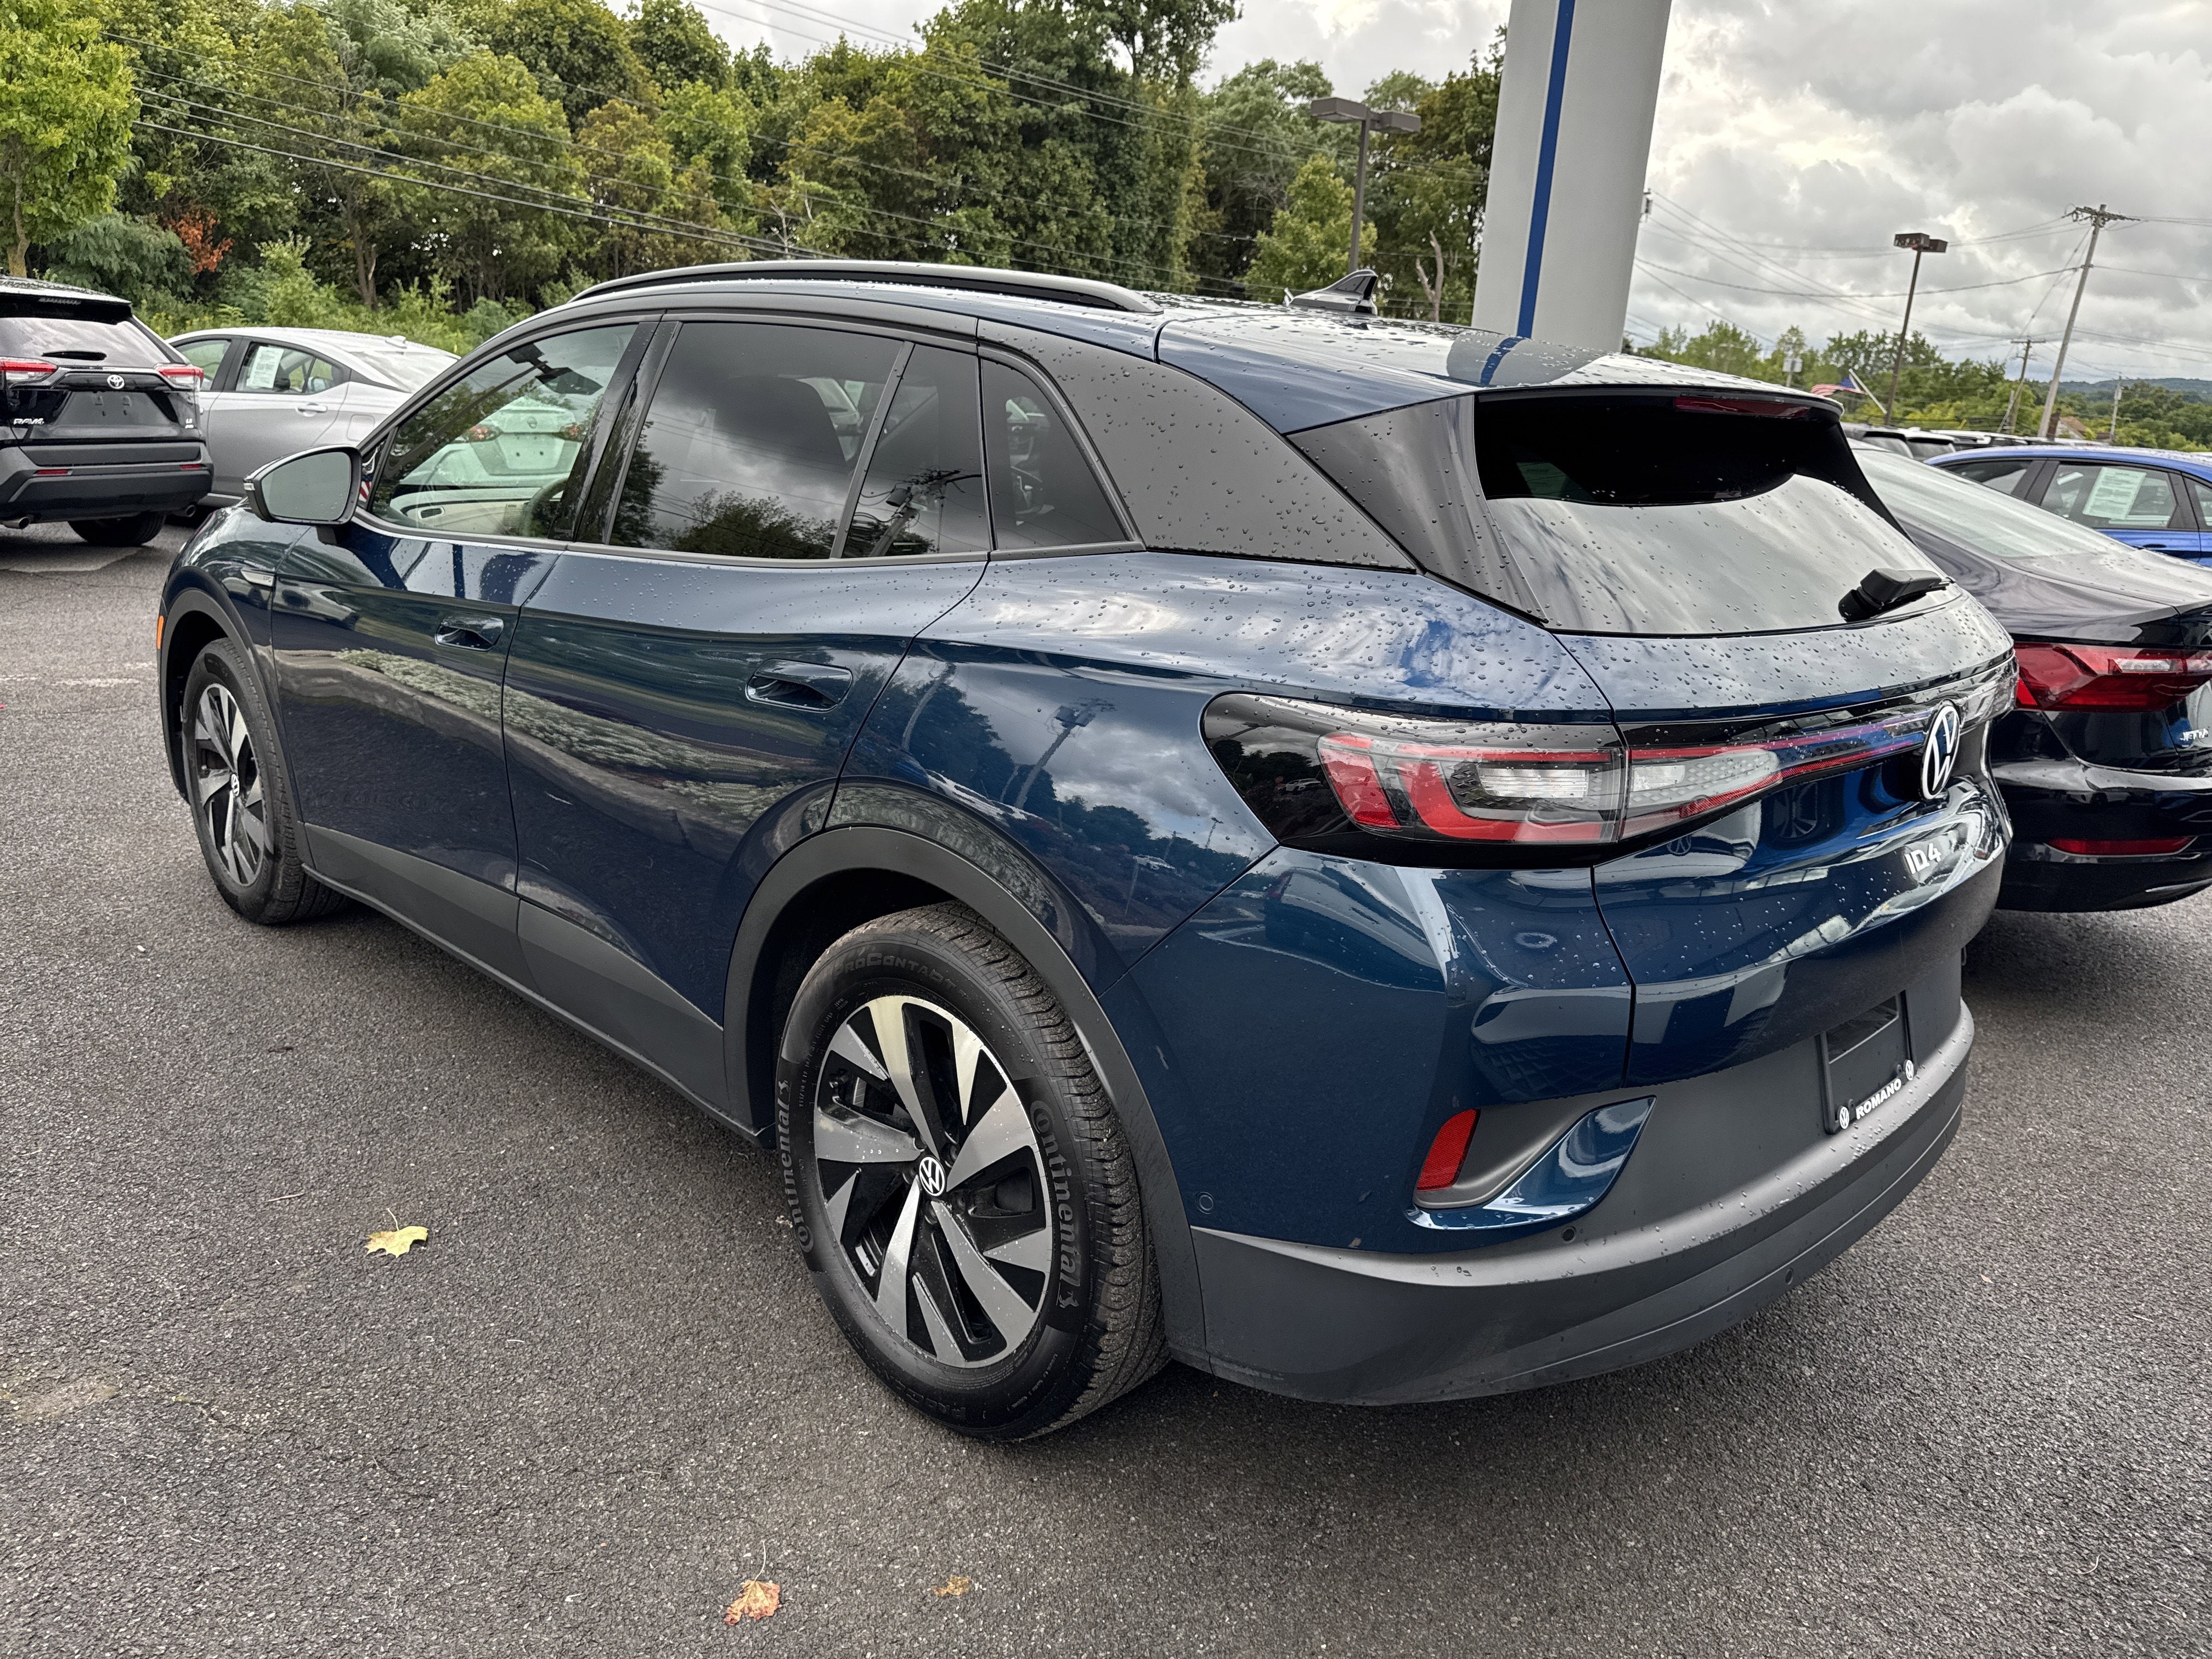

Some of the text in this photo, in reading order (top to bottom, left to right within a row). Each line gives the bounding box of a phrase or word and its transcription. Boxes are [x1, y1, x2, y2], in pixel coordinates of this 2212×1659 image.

[2180, 728, 2208, 742] JETTA
[1855, 1078, 1902, 1120] ROMANO
[777, 1097, 814, 1253] Continental
[1030, 1100, 1081, 1286] Continental
